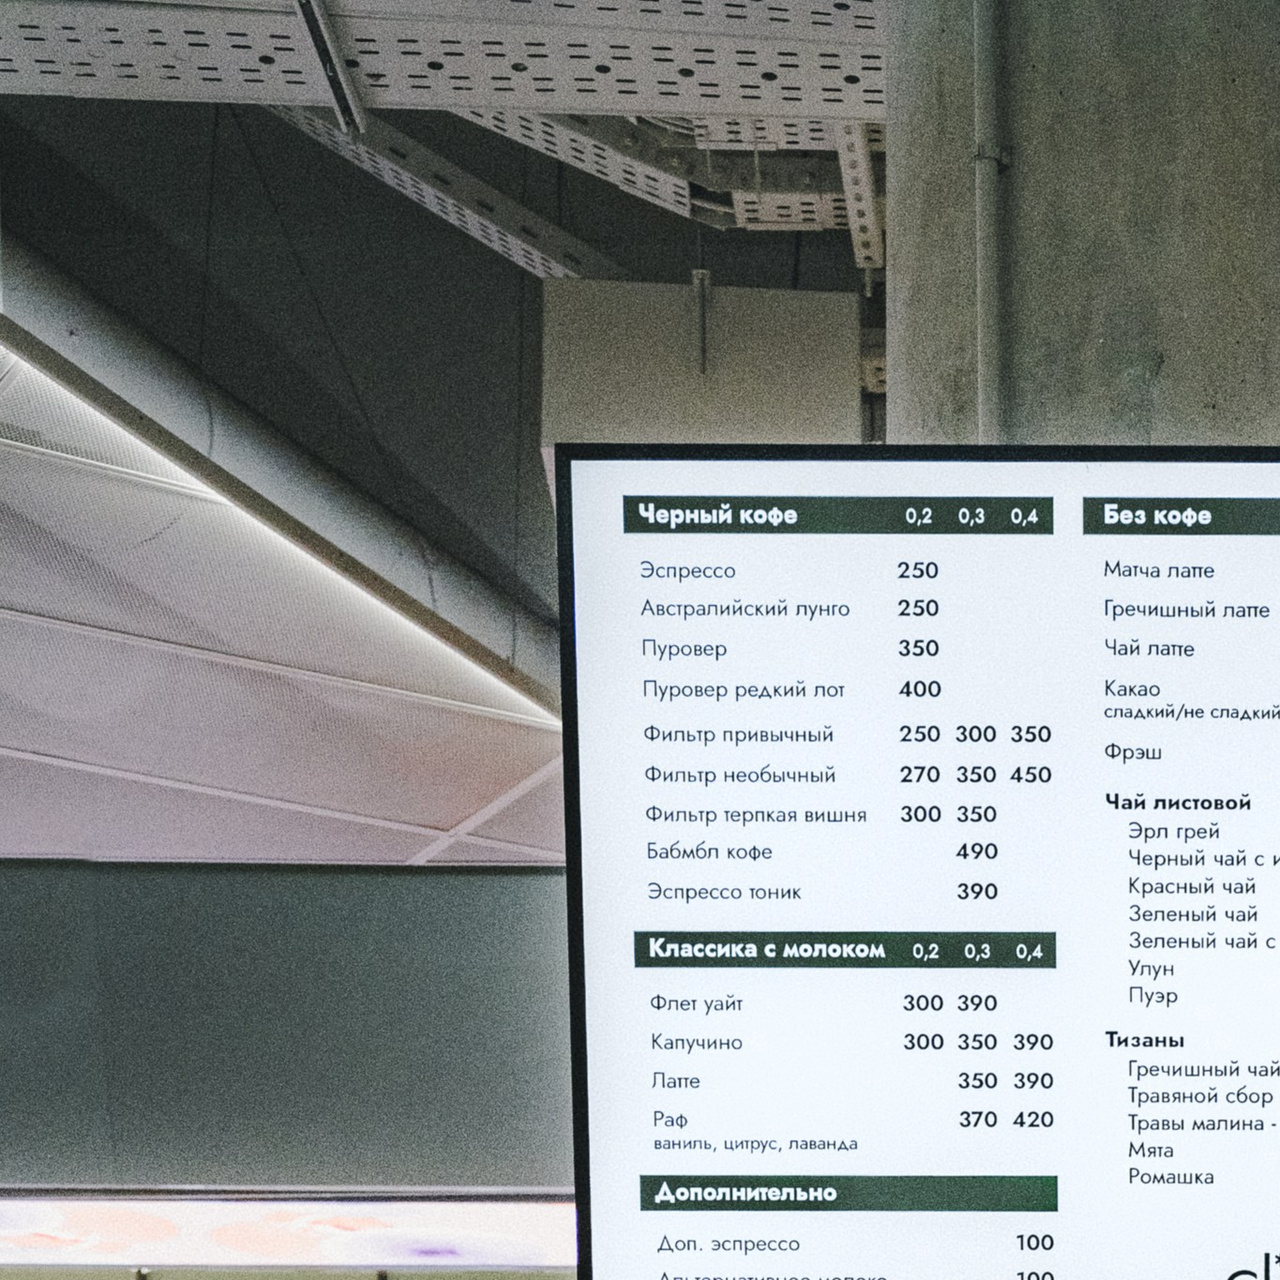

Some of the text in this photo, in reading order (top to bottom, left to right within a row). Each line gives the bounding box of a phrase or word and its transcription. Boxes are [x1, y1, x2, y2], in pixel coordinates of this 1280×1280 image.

[638, 502, 1039, 530] Черный кофе 0,2 0,3 0,4
[1104, 503, 1147, 525] Без
[1154, 507, 1212, 527] кофе
[640, 598, 939, 621] Австралийский лунго 250
[1104, 598, 1216, 622] Гречишный
[1223, 605, 1270, 619] латте
[1103, 703, 1280, 721] сладкий/не сладкий
[644, 764, 1052, 787] Фильтр необычный 270 350 450
[1128, 849, 1205, 872] Черный
[1213, 849, 1247, 867] чай
[1254, 854, 1264, 867] с
[649, 937, 1044, 962] Классика с молоком 0,2 0,3 0,4
[1128, 959, 1174, 981] Улун
[1129, 986, 1179, 1008] Пуэр
[651, 1033, 1054, 1055] Капучино 300 350 390
[653, 1139, 858, 1154] ваниль, цитрус, лаванда
[1129, 1167, 1214, 1185] Ромашка
[654, 1181, 838, 1204] Дополнительно
